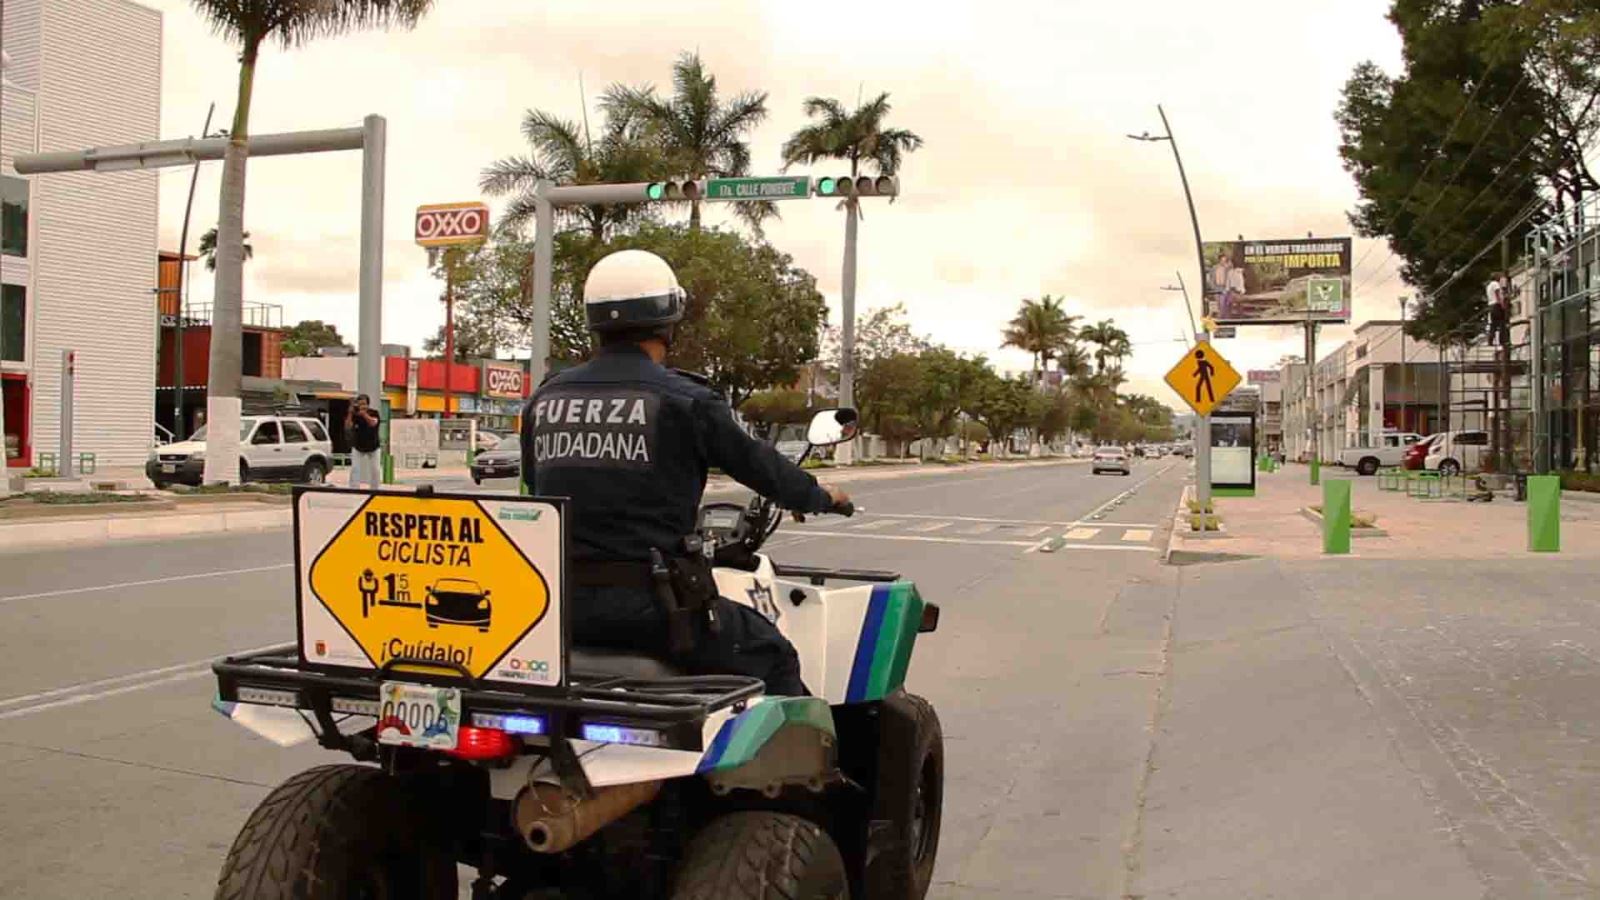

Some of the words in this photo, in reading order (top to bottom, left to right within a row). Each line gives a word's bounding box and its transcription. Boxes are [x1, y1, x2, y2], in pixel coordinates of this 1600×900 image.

[736, 183, 759, 196] CALLE
[760, 182, 796, 195] PONIENTE
[417, 211, 481, 239] OXXO
[1284, 253, 1341, 268] IMPORTA
[488, 370, 521, 392] OXXO
[535, 399, 647, 426] FUERZA
[534, 432, 650, 462] CIUDADANA
[365, 511, 454, 542] RESPETA
[459, 517, 484, 543] AL
[378, 540, 472, 567] CICLISTA
[381, 638, 473, 666] ¡Cuídalo!
